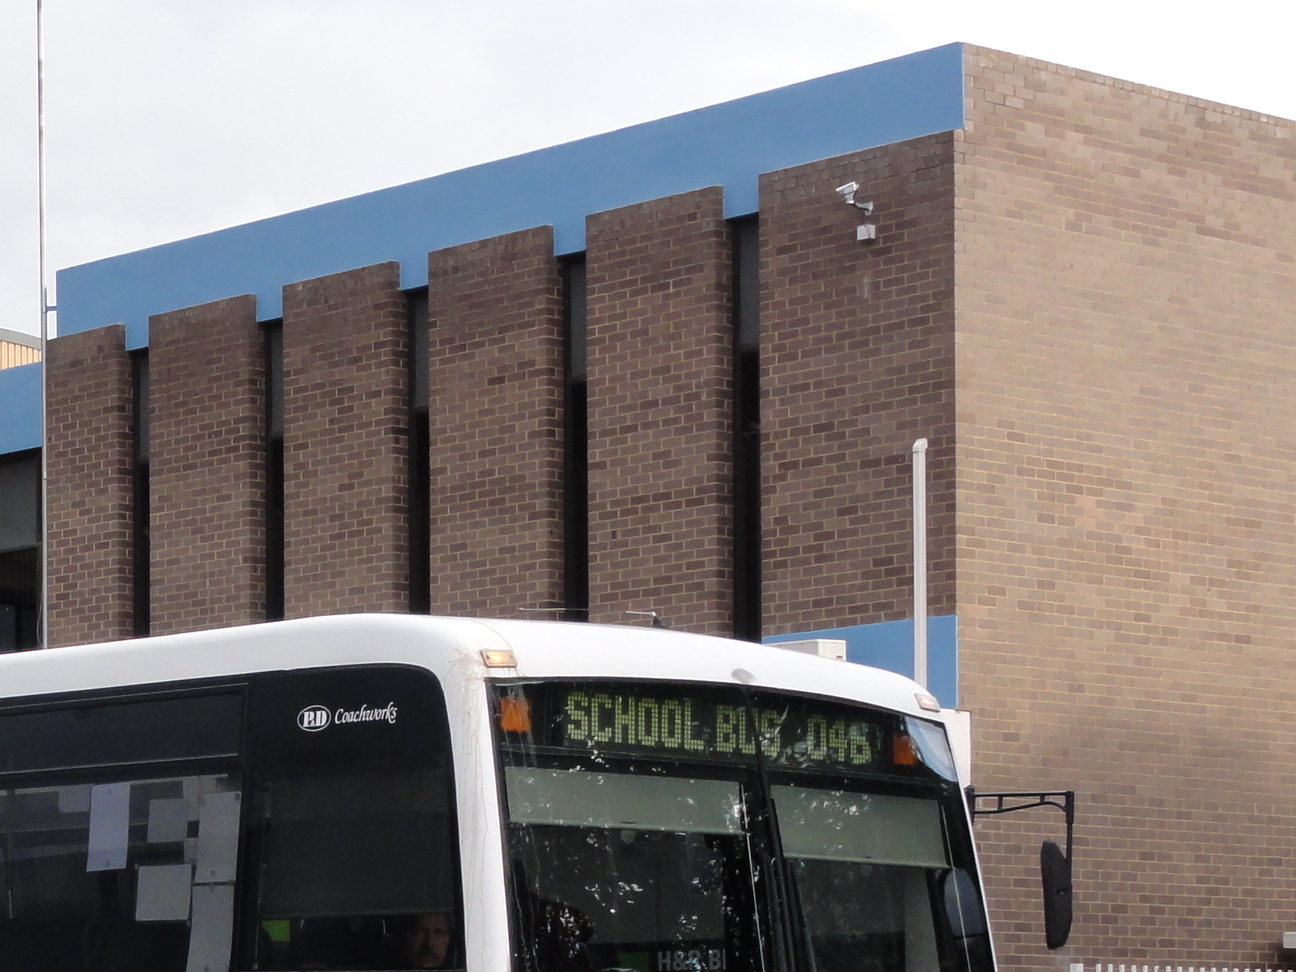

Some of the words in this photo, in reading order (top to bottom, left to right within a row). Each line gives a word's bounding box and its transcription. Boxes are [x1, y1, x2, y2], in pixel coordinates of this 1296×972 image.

[334, 701, 398, 725] Coachworks
[566, 691, 704, 752] SCHOOL
[715, 704, 782, 759] BUS
